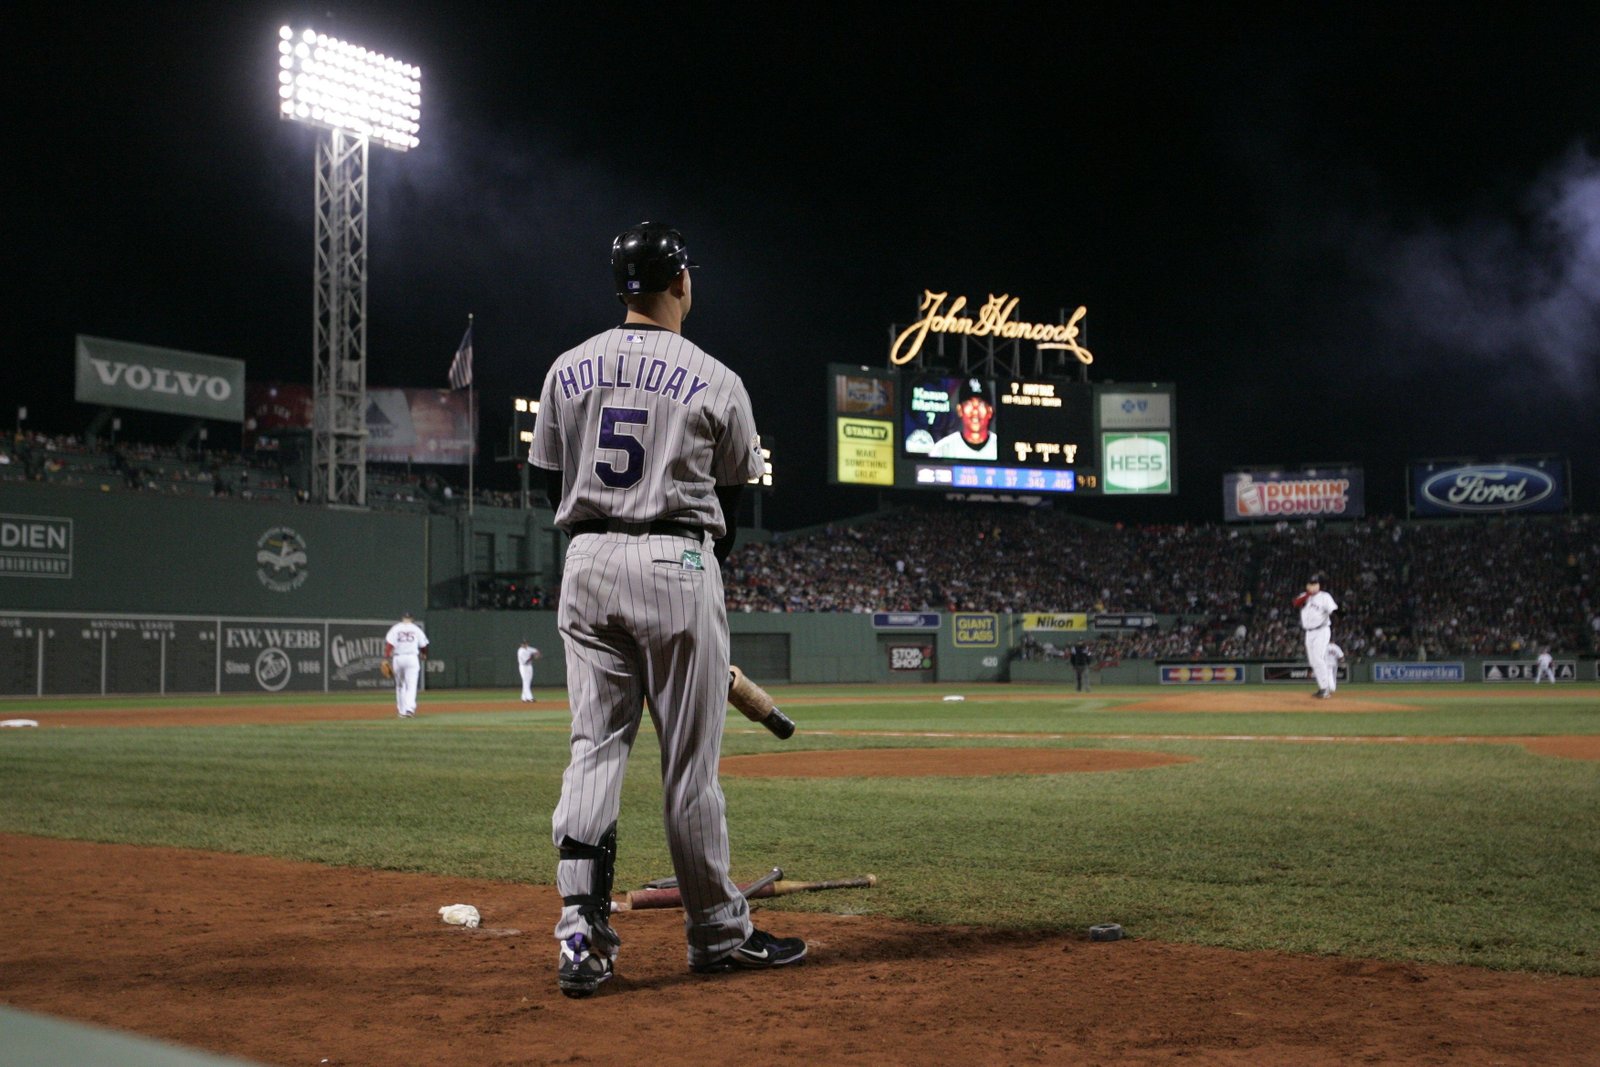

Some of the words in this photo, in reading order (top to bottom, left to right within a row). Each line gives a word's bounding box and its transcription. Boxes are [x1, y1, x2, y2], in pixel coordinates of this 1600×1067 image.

[627, 263, 636, 276] 5
[890, 289, 974, 364] John
[970, 293, 1094, 365] Hancock
[89, 358, 231, 400] VOLVO
[557, 353, 710, 406] HOLLIDAY
[926, 411, 936, 425] 7
[845, 426, 886, 439] STANLEY
[594, 406, 649, 491] 5
[856, 448, 877, 458] MAKE
[845, 458, 888, 470] SOMETHING
[1110, 455, 1162, 471] HESS
[1266, 479, 1349, 499] DUNKIN'
[1449, 470, 1526, 504] Ford
[1266, 498, 1347, 514] DONUTS
[1, 523, 66, 549] DIEN
[959, 618, 993, 630] GIANT
[1036, 616, 1073, 628] Nikon
[264, 629, 321, 649] WEBB
[958, 630, 993, 641] GLASS
[225, 660, 250, 674] Since
[982, 657, 998, 667] 420
[1396, 665, 1459, 680] Connection
